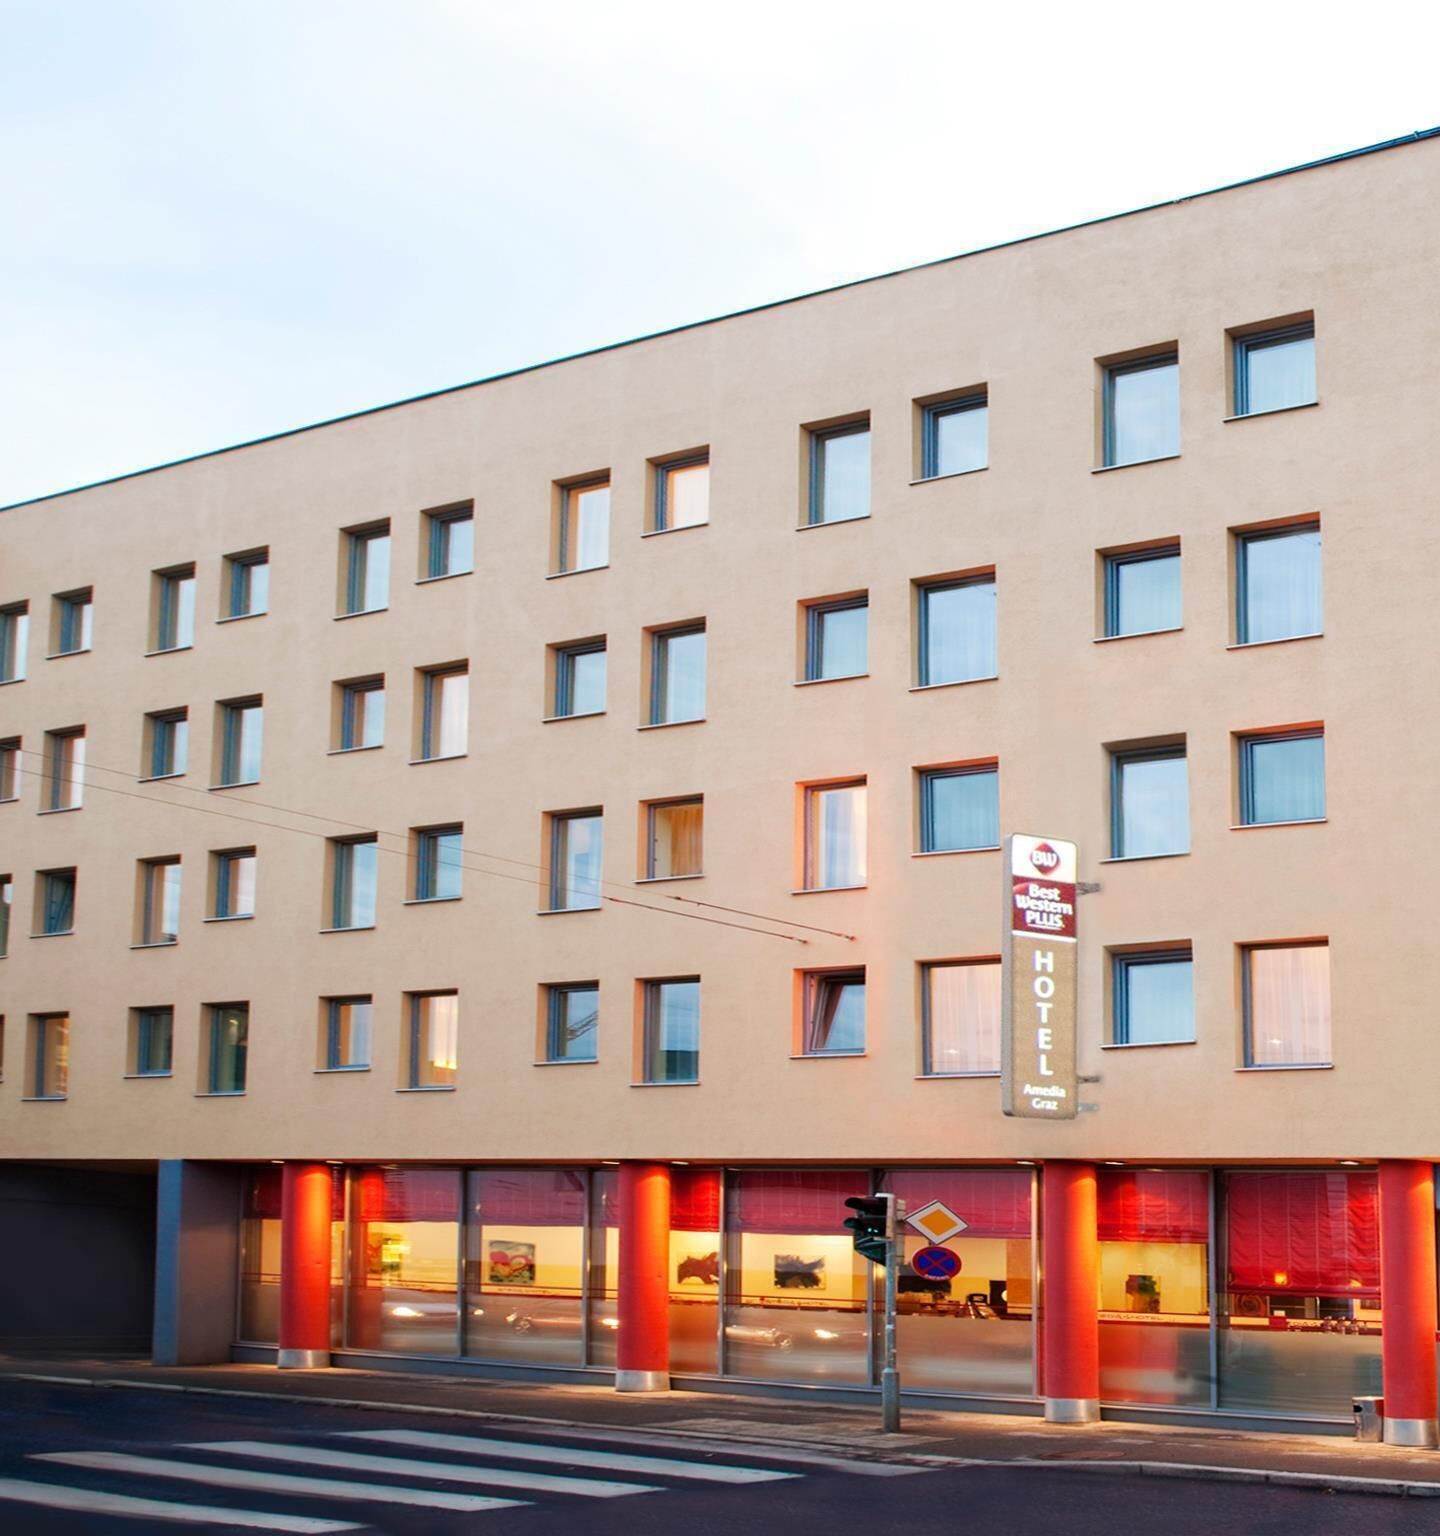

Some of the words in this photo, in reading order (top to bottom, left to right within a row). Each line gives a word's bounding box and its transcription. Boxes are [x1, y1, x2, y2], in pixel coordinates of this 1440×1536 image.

[1032, 850, 1058, 868] BW
[1028, 884, 1061, 900] Best
[1015, 894, 1073, 914] Western
[1034, 950, 1055, 1076] HOTEL
[1023, 1083, 1066, 1098] Amedia
[1031, 1098, 1059, 1111] Graz
